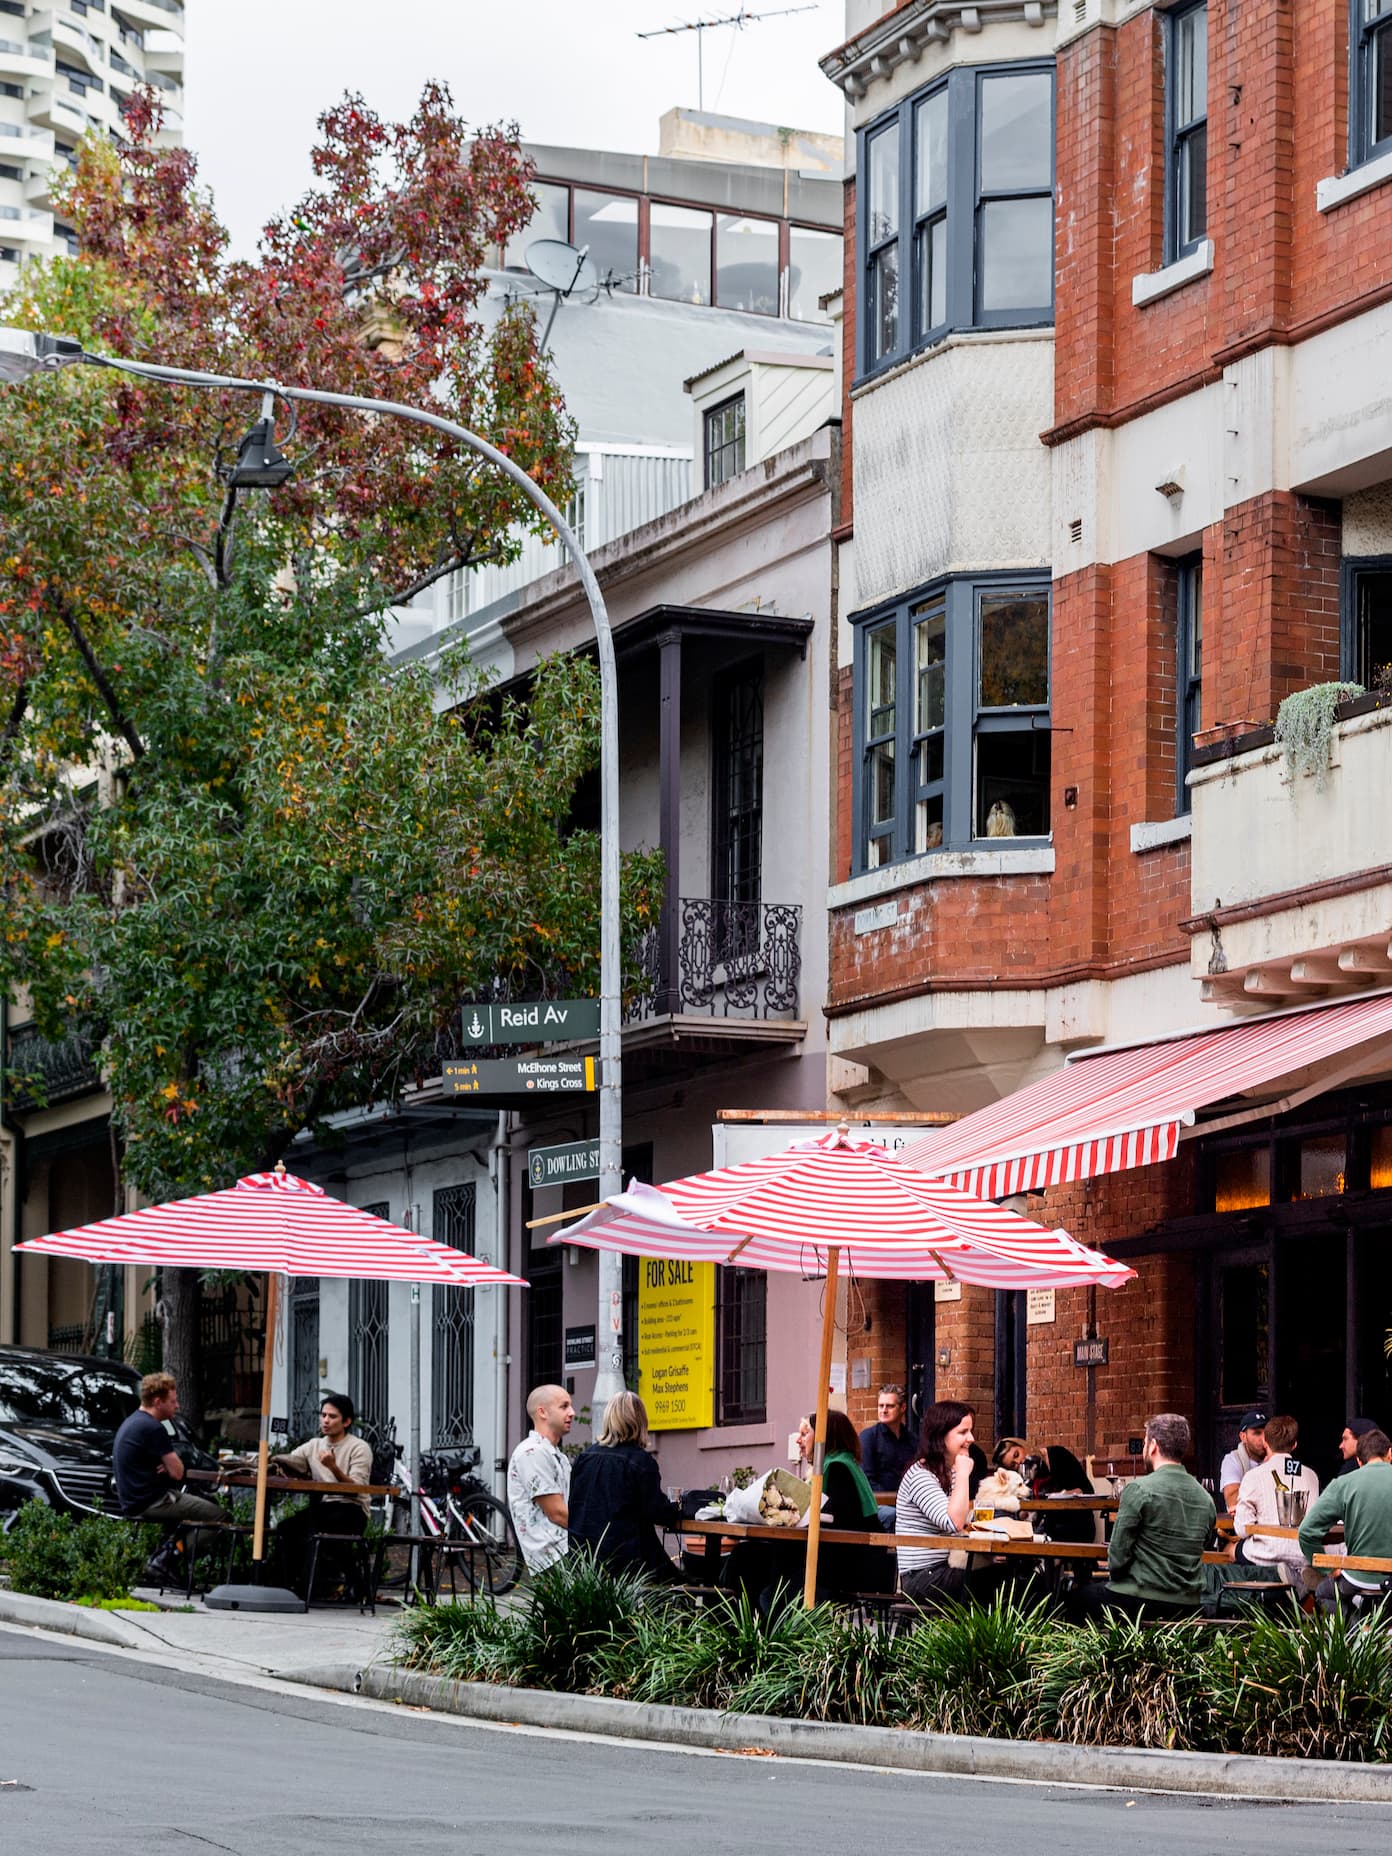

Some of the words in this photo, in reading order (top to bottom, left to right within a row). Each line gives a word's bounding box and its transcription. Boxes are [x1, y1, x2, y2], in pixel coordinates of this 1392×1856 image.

[500, 1006, 539, 1028] Reid
[543, 1005, 569, 1024] Av
[517, 1062, 556, 1074] McElhone
[558, 1062, 582, 1073] Street
[536, 1078, 559, 1091] Kings
[560, 1078, 583, 1089] Cross
[547, 1152, 587, 1175] DOWLING
[589, 1150, 600, 1168] ST
[646, 1261, 665, 1289] FOR
[668, 1260, 694, 1285] SALE
[566, 1343, 594, 1354] PRACTICE
[651, 1367, 668, 1380] Logan
[652, 1383, 664, 1394] Max
[664, 1382, 689, 1395] Stephens
[655, 1400, 670, 1414] 9969
[671, 1399, 686, 1413] 1500
[273, 1420, 287, 1432] 98
[1286, 1459, 1300, 1474] 97
